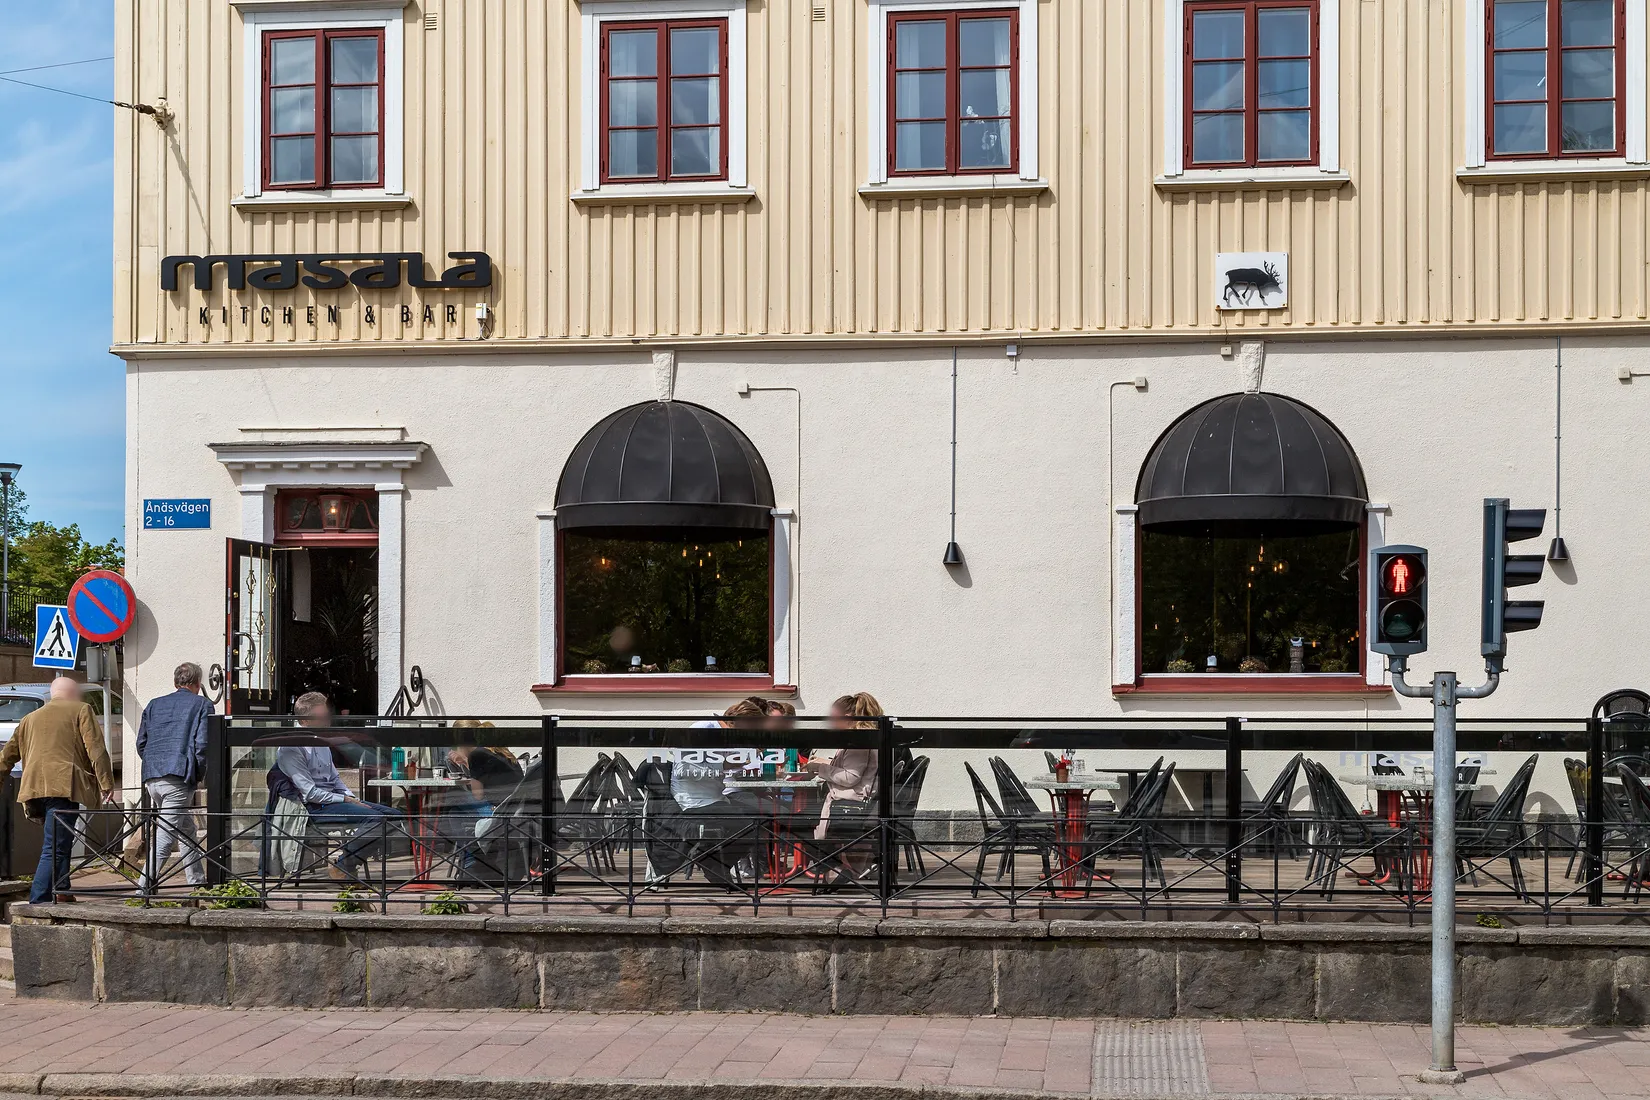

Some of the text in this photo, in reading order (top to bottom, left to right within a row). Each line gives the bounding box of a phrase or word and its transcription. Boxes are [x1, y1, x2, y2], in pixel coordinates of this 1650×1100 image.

[161, 251, 493, 291] masala
[199, 304, 458, 325] KITCHEN & BAR
[145, 501, 209, 514] Ånäsvägen
[145, 516, 153, 526] 2
[164, 516, 175, 526] 16
[673, 769, 720, 777] KITCHEN
[742, 769, 763, 777] BAR
